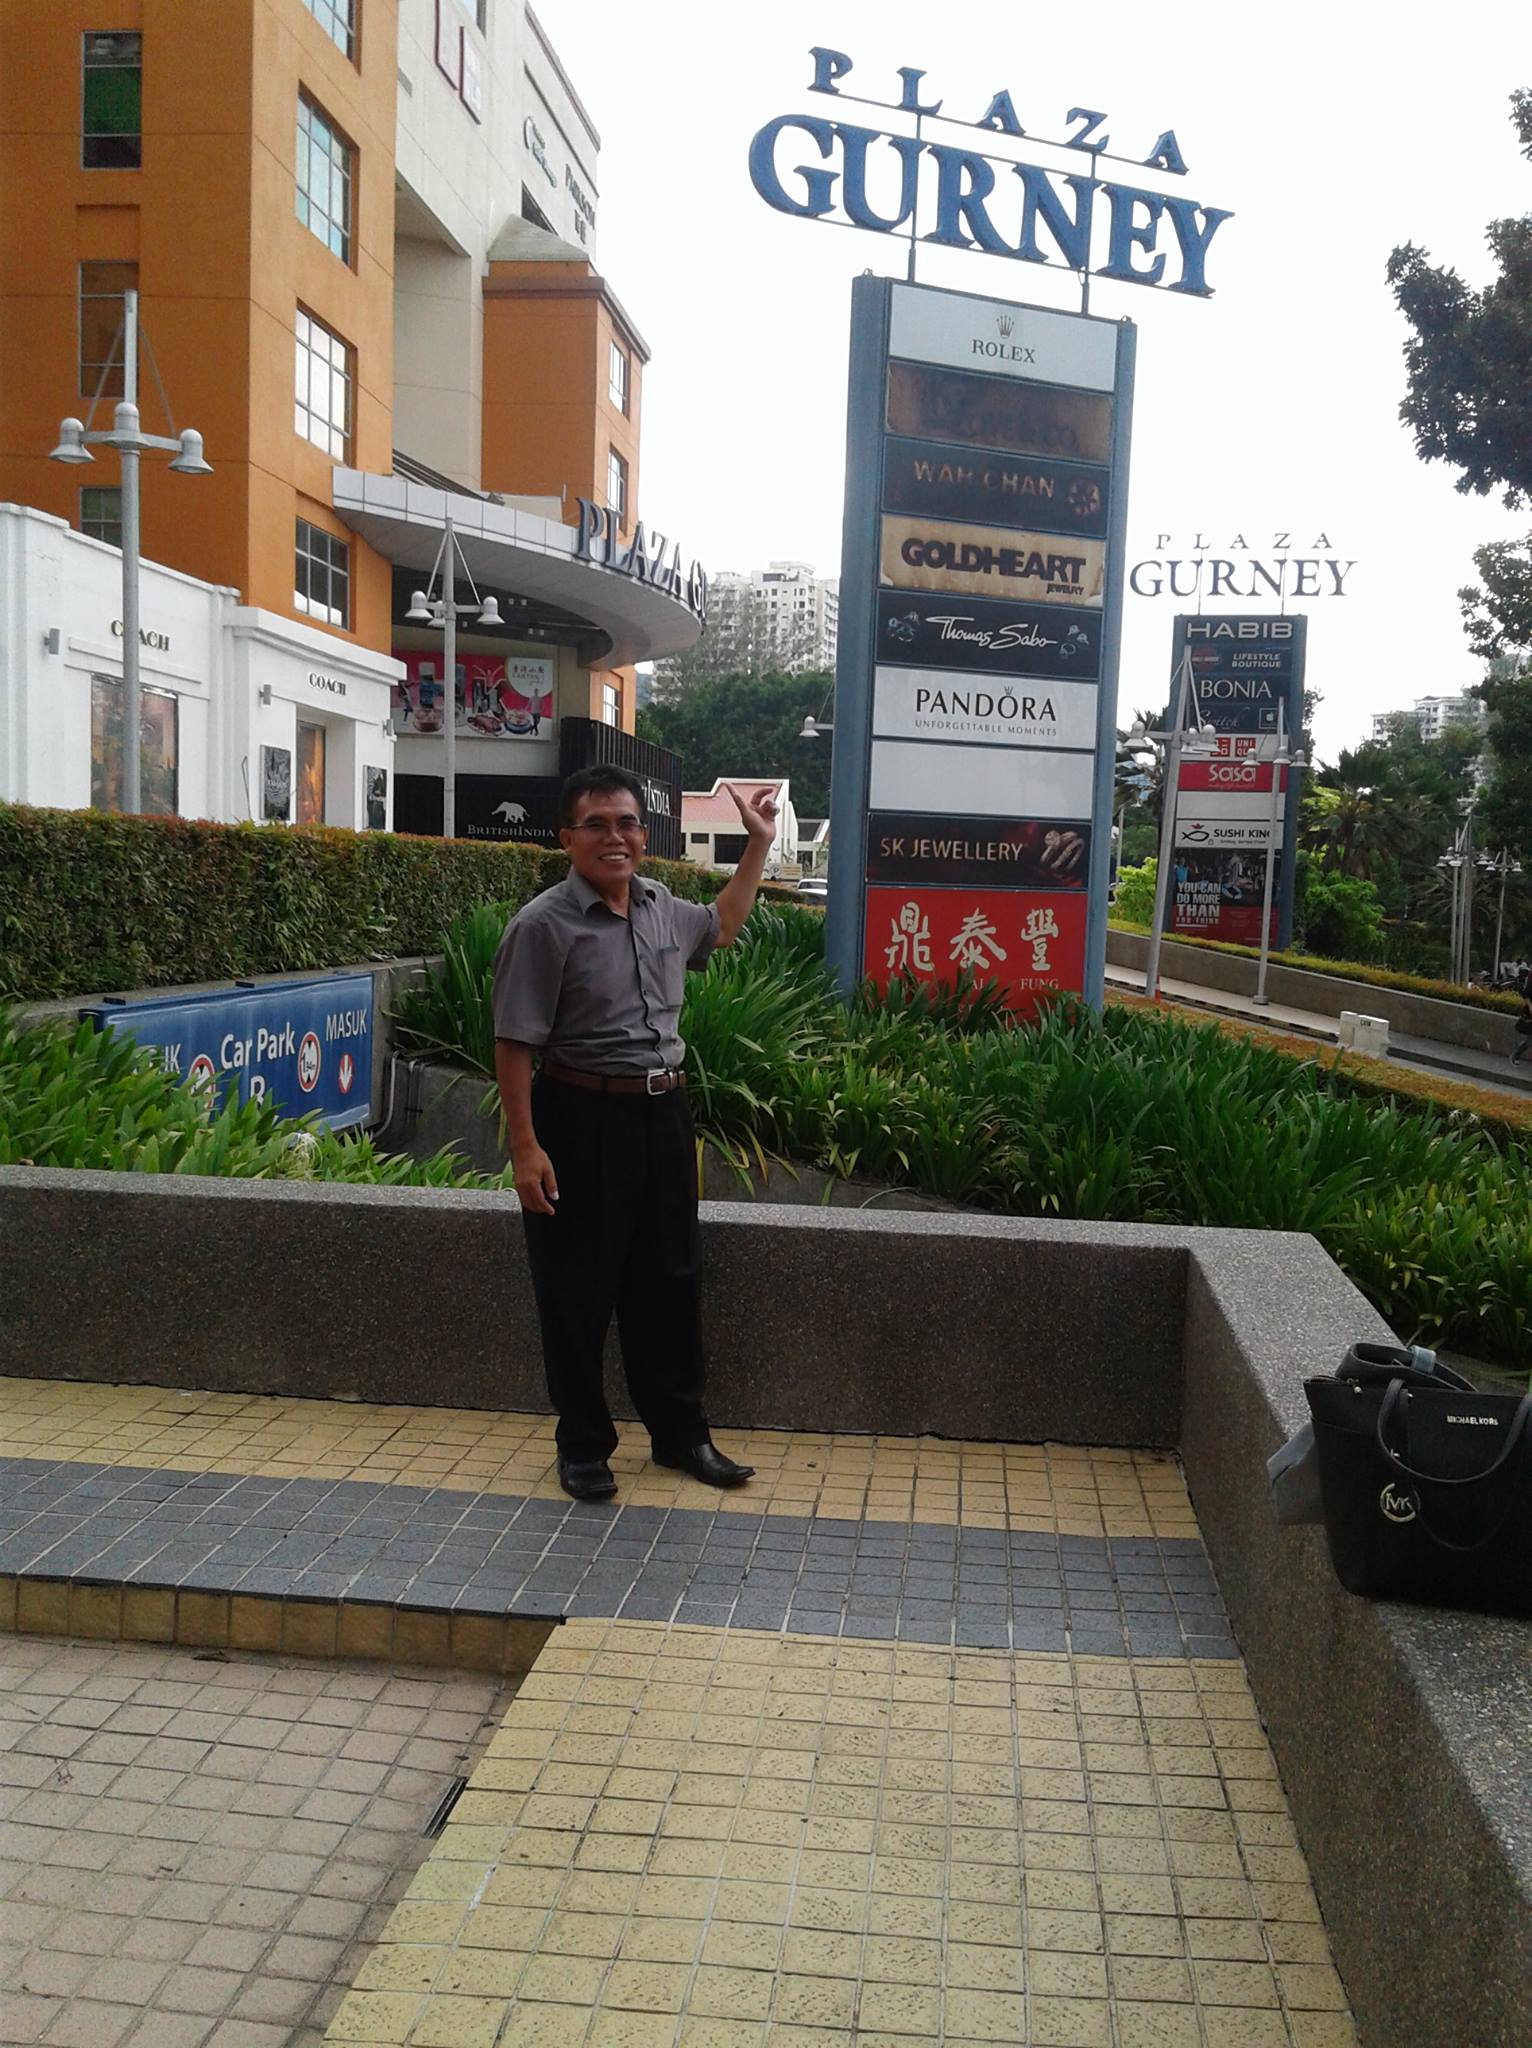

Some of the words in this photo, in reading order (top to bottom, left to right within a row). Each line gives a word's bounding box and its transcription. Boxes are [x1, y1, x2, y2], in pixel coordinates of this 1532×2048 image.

[807, 46, 1189, 175] PLAZA
[748, 114, 1235, 296] GURNEY
[971, 339, 1036, 363] ROLEX
[573, 497, 682, 600] PLAZA
[1155, 533, 1333, 550] PLAZA
[901, 538, 1086, 584] GOLDHEART
[1129, 560, 1358, 597] GURNEY
[111, 620, 170, 652] CACH
[925, 616, 993, 646] Thomas
[988, 623, 1058, 650] Sabo
[1186, 622, 1293, 638] HABIB
[308, 673, 347, 696] COACH
[1201, 680, 1272, 698] BONIA
[915, 688, 1057, 721] PANDORA
[915, 719, 1001, 733] UNFORGETTABLE
[1008, 725, 1057, 737] MOMENTS
[1213, 829, 1244, 838] SUSHI
[880, 838, 905, 857] SK
[911, 839, 1024, 860] JEWELLERY
[1177, 881, 1198, 893] YOU
[1200, 881, 1221, 893] CAN
[1176, 893, 1190, 904] DO
[1192, 893, 1220, 905] MORE
[1176, 904, 1220, 917] THAN
[1021, 978, 1059, 990] FUNG
[326, 1008, 367, 1041] MASUK
[221, 1034, 254, 1069] Car
[257, 1021, 296, 1062] Park
[1447, 1416, 1478, 1425] MICHAEL
[1479, 1417, 1499, 1426] KORS
